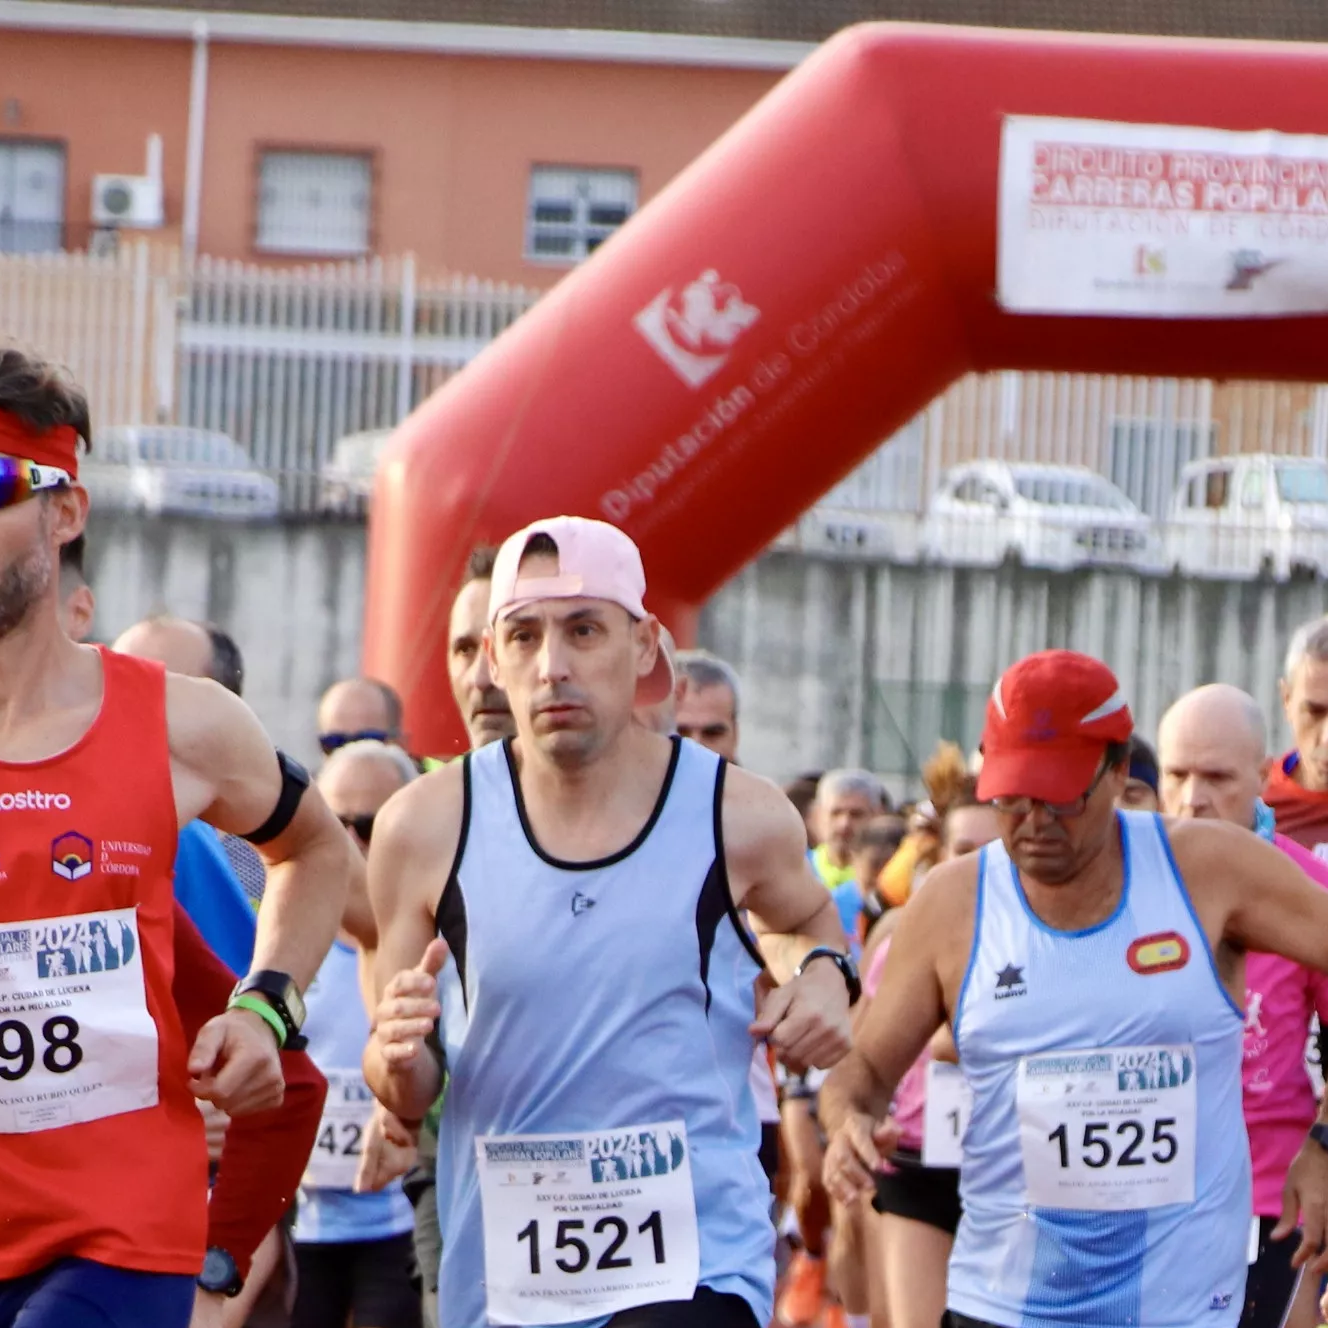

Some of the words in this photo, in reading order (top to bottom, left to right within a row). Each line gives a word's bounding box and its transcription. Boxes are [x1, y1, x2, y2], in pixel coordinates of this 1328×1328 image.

[1033, 147, 1164, 176] CIRCUITO
[1031, 173, 1196, 209] CARRERAS
[32, 921, 93, 951] 2024
[12, 989, 44, 1002] CIUDAD
[45, 988, 56, 998] DE
[57, 983, 92, 996] LUCENA
[994, 987, 1028, 1000] luanvi
[13, 1004, 26, 1013] LA
[587, 1132, 643, 1160] 2024
[1048, 1117, 1179, 1169] 1525
[517, 1210, 666, 1275] 1521
